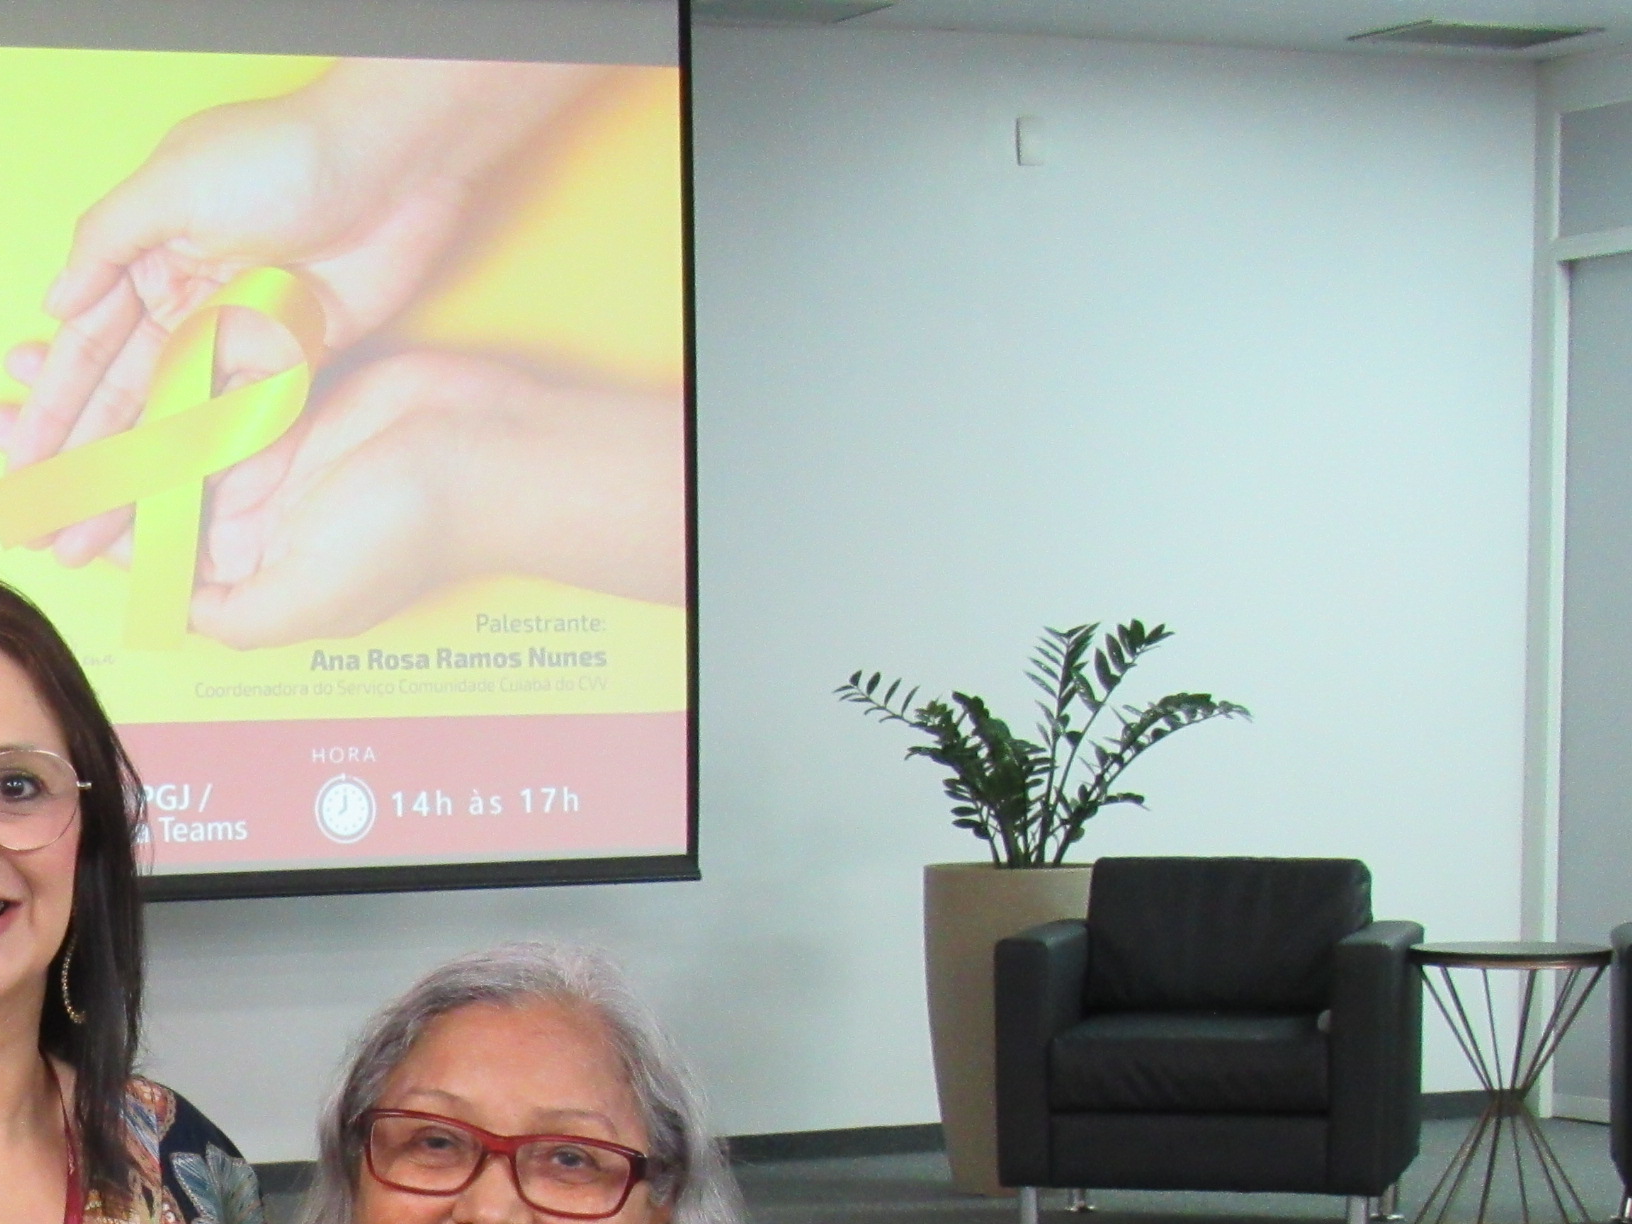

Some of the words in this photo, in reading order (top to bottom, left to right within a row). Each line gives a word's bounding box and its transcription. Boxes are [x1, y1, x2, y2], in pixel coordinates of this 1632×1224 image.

[476, 612, 607, 634] Palestrante:
[311, 649, 361, 671] Ana
[368, 648, 430, 671] Rosa
[437, 647, 523, 669] Ramos
[529, 646, 608, 668] Nunes
[194, 681, 310, 699] Coordenadora
[313, 680, 334, 697] do
[398, 677, 497, 695] Comunidade
[311, 747, 377, 763] HORA
[391, 790, 454, 817] 14h
[468, 789, 502, 815] às
[520, 786, 580, 813] 17h
[158, 817, 248, 843] Teams
